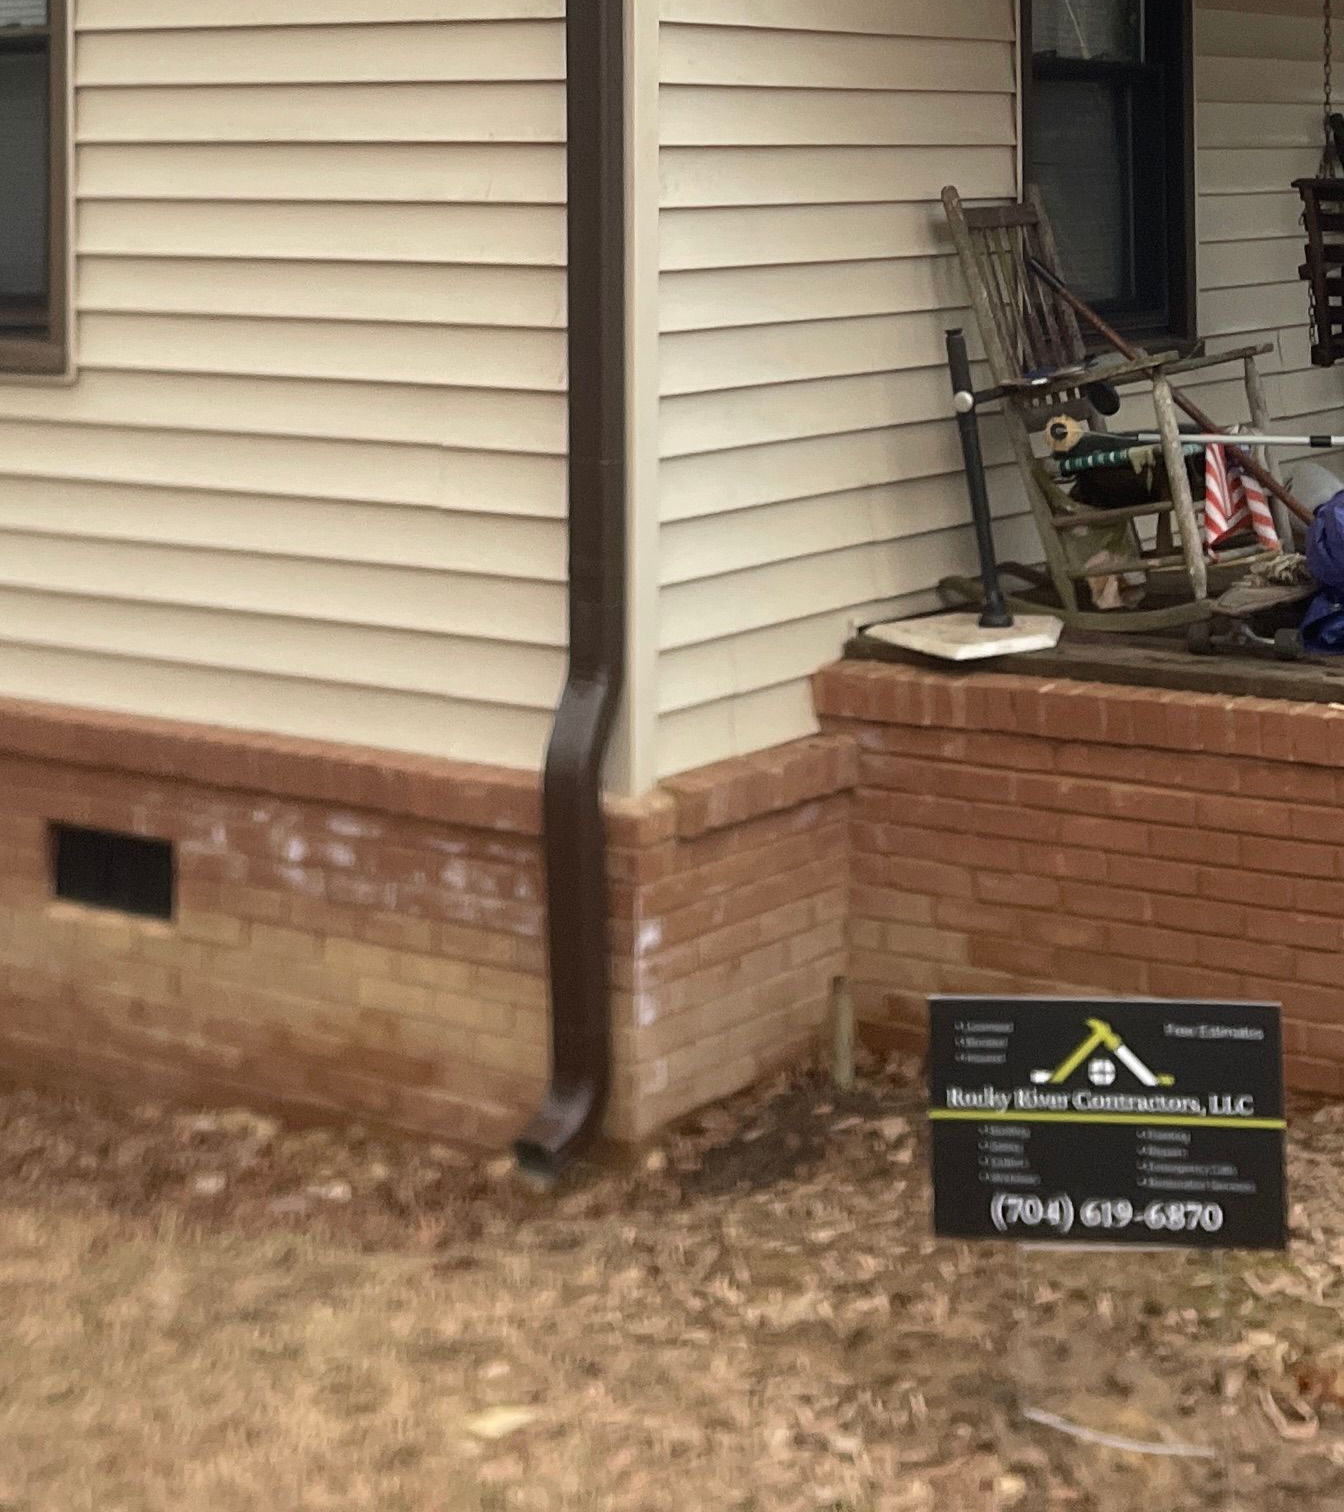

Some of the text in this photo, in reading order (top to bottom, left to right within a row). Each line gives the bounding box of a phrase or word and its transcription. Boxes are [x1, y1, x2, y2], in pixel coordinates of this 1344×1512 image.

[1013, 1086, 1069, 1110] River
[1071, 1089, 1207, 1117] Contractors,
[1208, 1092, 1255, 1116] LLC
[990, 1192, 1224, 1234] (704) 619-6870
